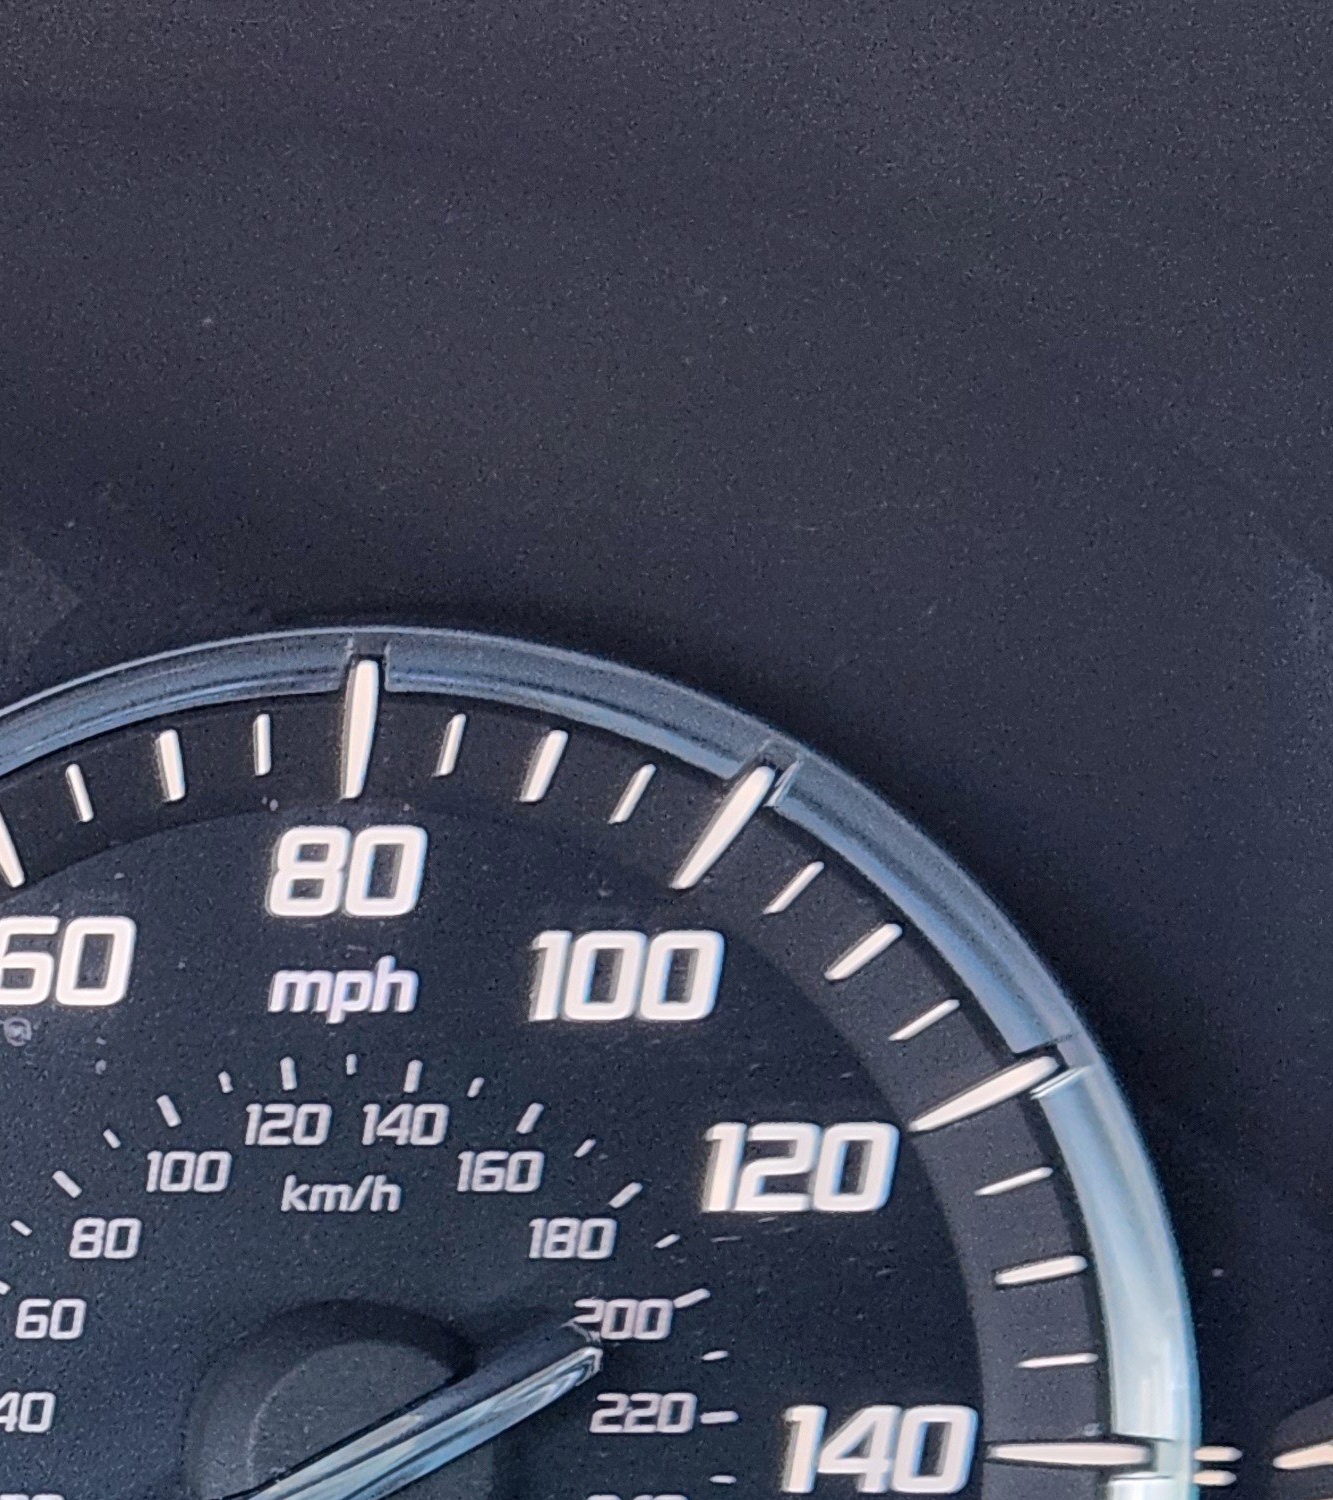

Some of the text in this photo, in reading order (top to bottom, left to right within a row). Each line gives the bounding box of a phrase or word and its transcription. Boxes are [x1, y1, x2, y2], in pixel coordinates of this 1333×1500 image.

[263, 824, 428, 918] 80
[266, 954, 419, 1025] mph
[528, 928, 725, 1023] 100
[243, 1102, 333, 1147] 120
[360, 1102, 450, 1147] 140
[145, 1149, 233, 1194] 100
[455, 1149, 545, 1194] 160
[700, 1121, 900, 1214] 120
[279, 1173, 402, 1213] km/h
[68, 1216, 142, 1260] 80
[527, 1216, 617, 1261] 180
[14, 1297, 88, 1341] 60
[571, 1298, 674, 1342] 200
[588, 1391, 698, 1435] 220
[781, 1403, 977, 1495] 140
